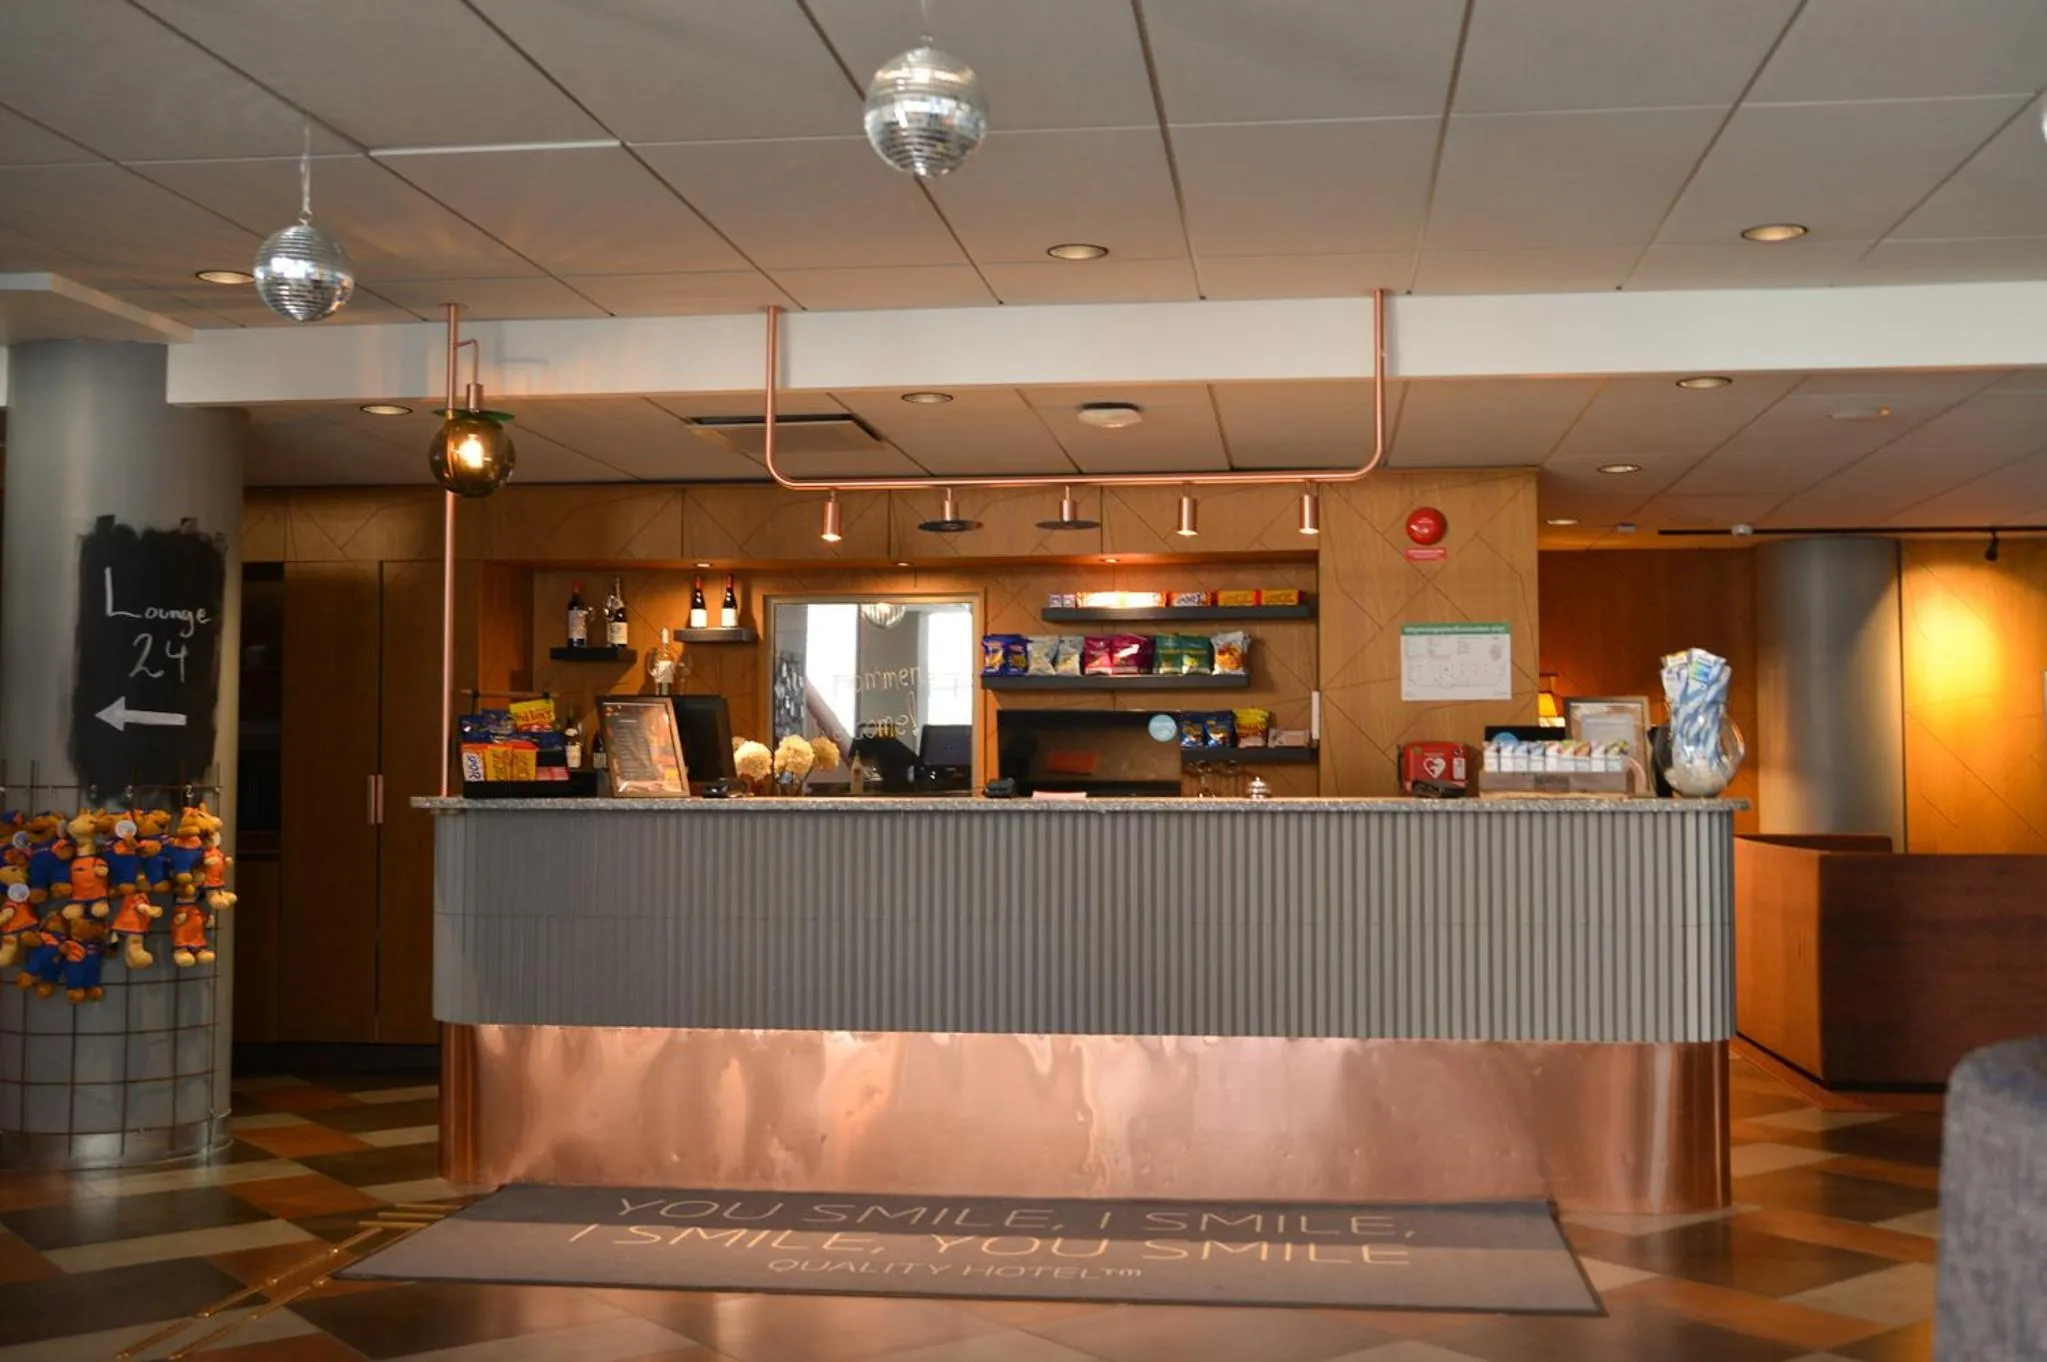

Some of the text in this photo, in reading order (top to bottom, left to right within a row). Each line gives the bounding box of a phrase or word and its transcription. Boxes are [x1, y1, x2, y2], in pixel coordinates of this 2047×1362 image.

[104, 566, 211, 638] Lounge
[128, 632, 188, 683] 24
[617, 1198, 1417, 1239] YOU SMILE, I SMILE,
[568, 1223, 1411, 1265] I SMILE, YOU SMILE
[767, 1258, 953, 1277] QUALITY
